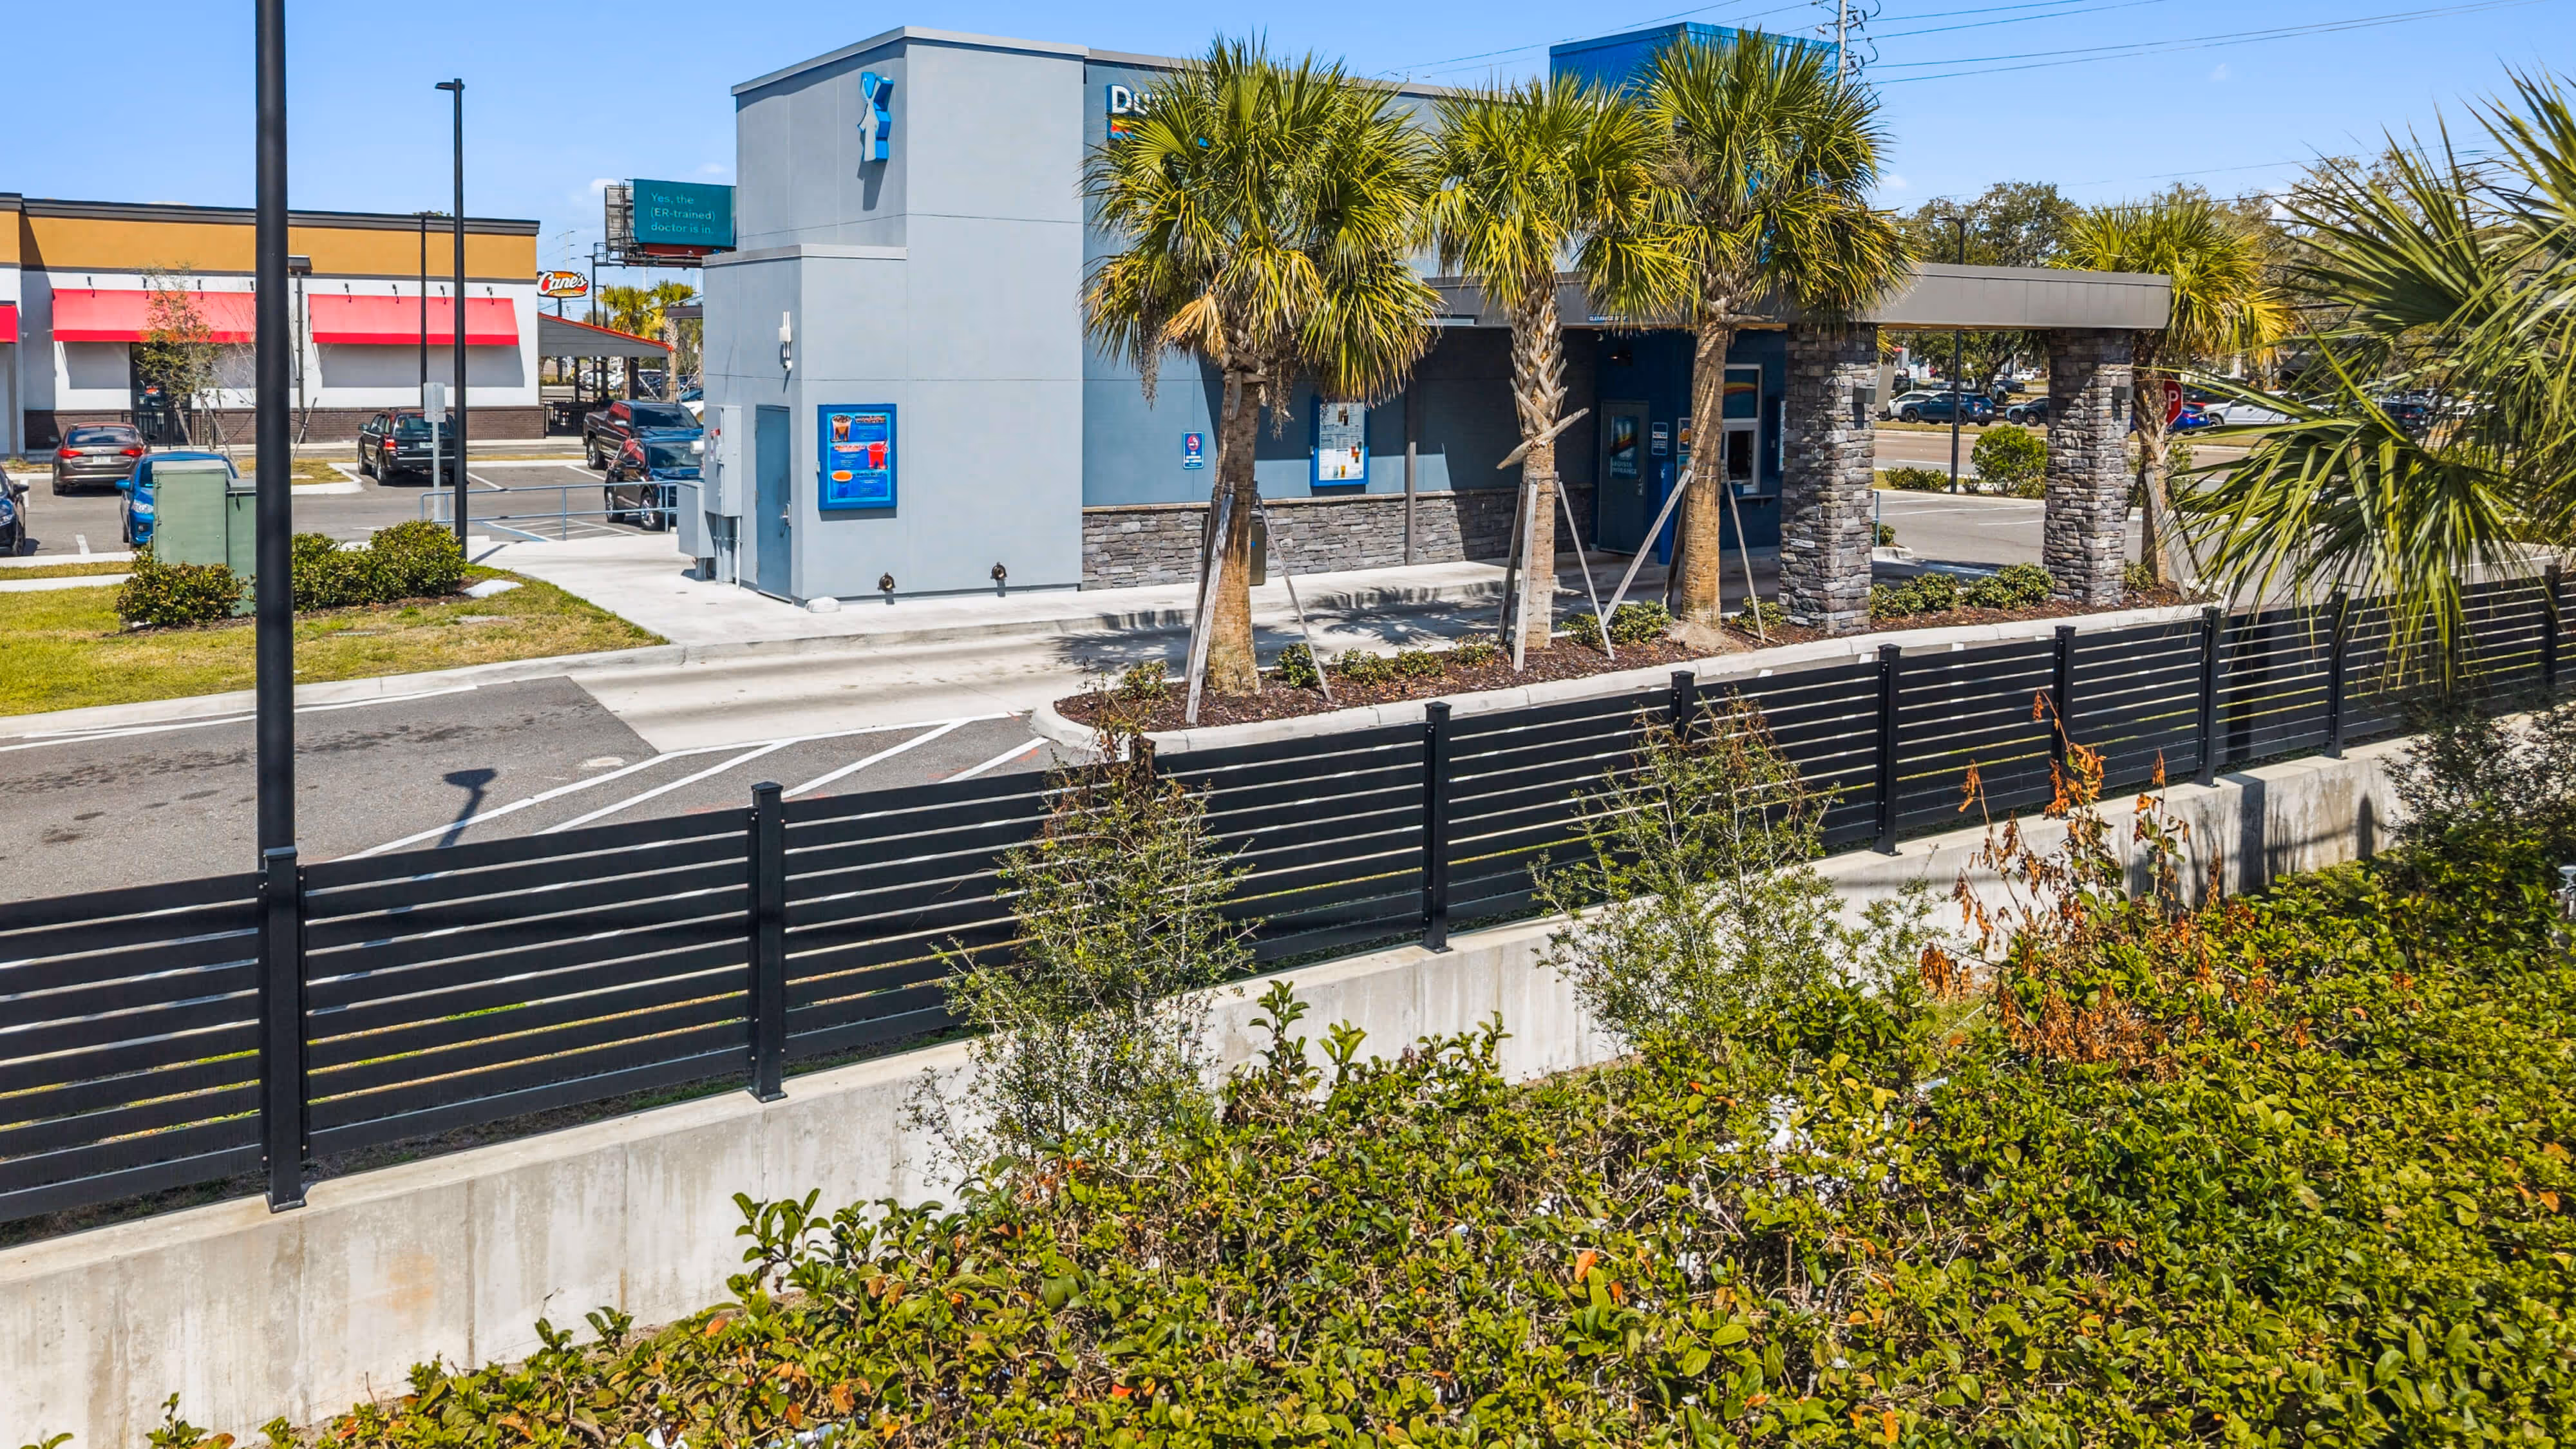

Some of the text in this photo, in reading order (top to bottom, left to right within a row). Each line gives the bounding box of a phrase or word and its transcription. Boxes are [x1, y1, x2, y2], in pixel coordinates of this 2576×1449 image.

[651, 192, 694, 205] Yes, the
[650, 207, 715, 222] (ER-trained)
[651, 222, 715, 235] doctor is in.
[537, 272, 587, 295] Cane's
